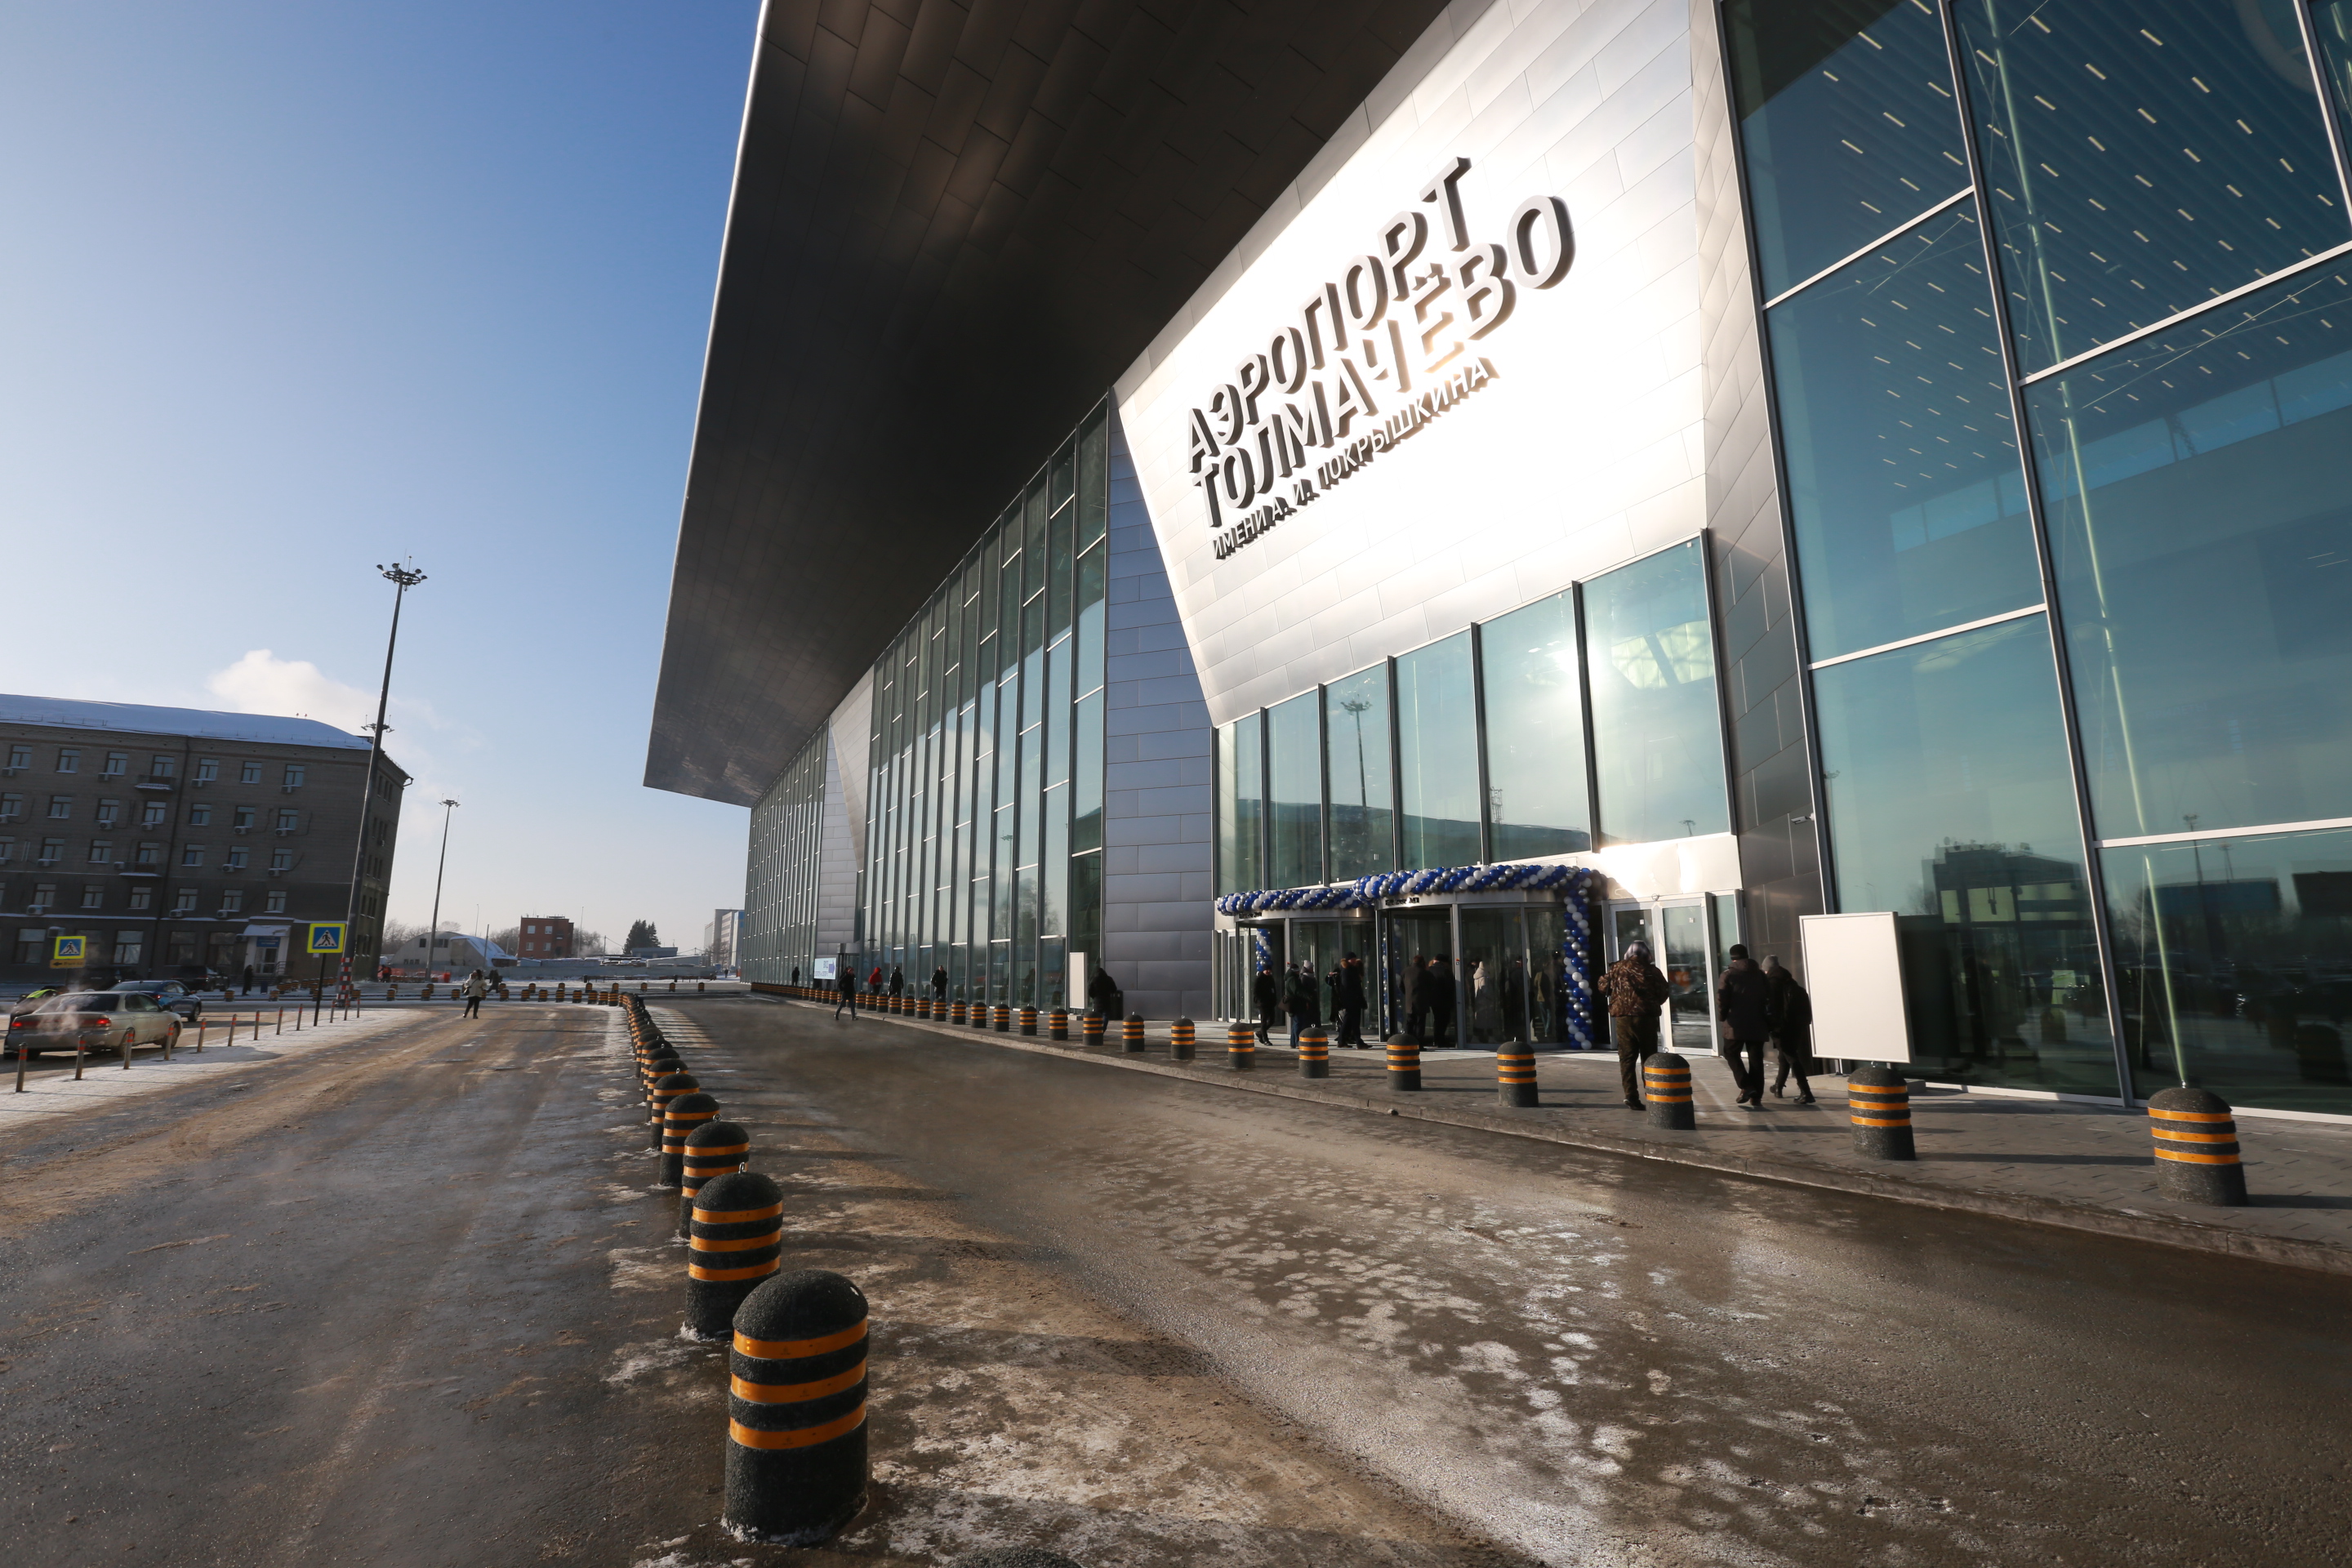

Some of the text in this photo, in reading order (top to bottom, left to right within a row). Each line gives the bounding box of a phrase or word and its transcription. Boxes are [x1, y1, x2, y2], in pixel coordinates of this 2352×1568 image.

[1187, 157, 1472, 473] АЭРОПОРТ
[1213, 506, 1274, 559] ИМЕНИ
[1316, 357, 1499, 490] ПОКРЫШКИНА
